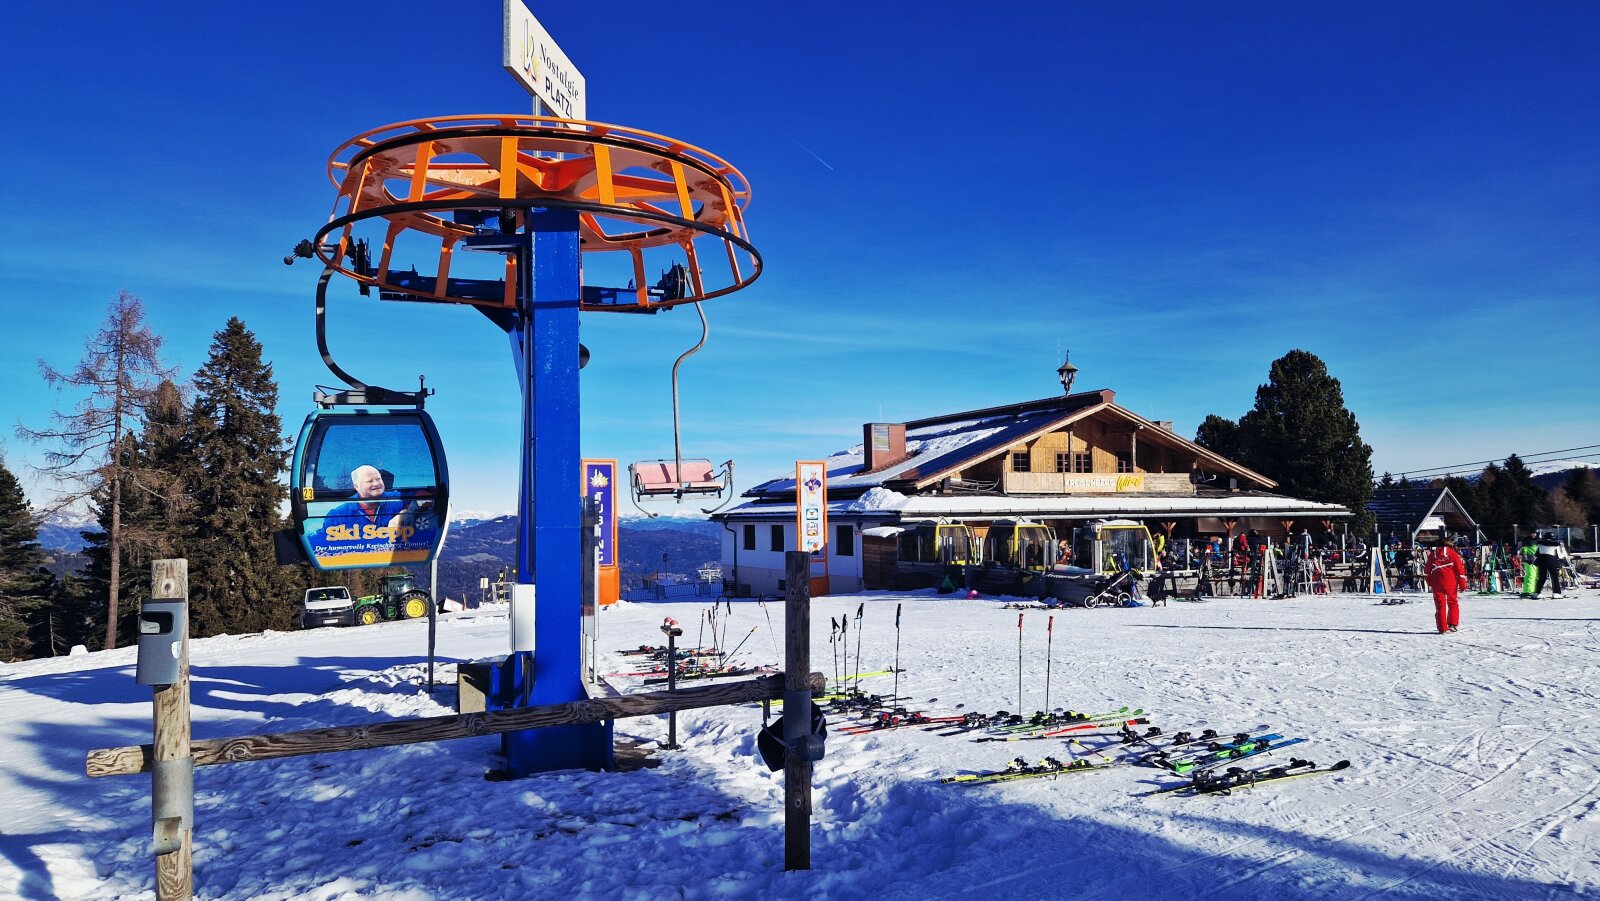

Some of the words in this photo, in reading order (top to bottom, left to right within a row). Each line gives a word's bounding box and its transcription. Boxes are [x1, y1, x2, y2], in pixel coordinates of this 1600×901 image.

[540, 43, 579, 100] Nostalgie
[304, 488, 313, 499] 23
[326, 524, 360, 541] Ski
[363, 524, 415, 543] Sepp
